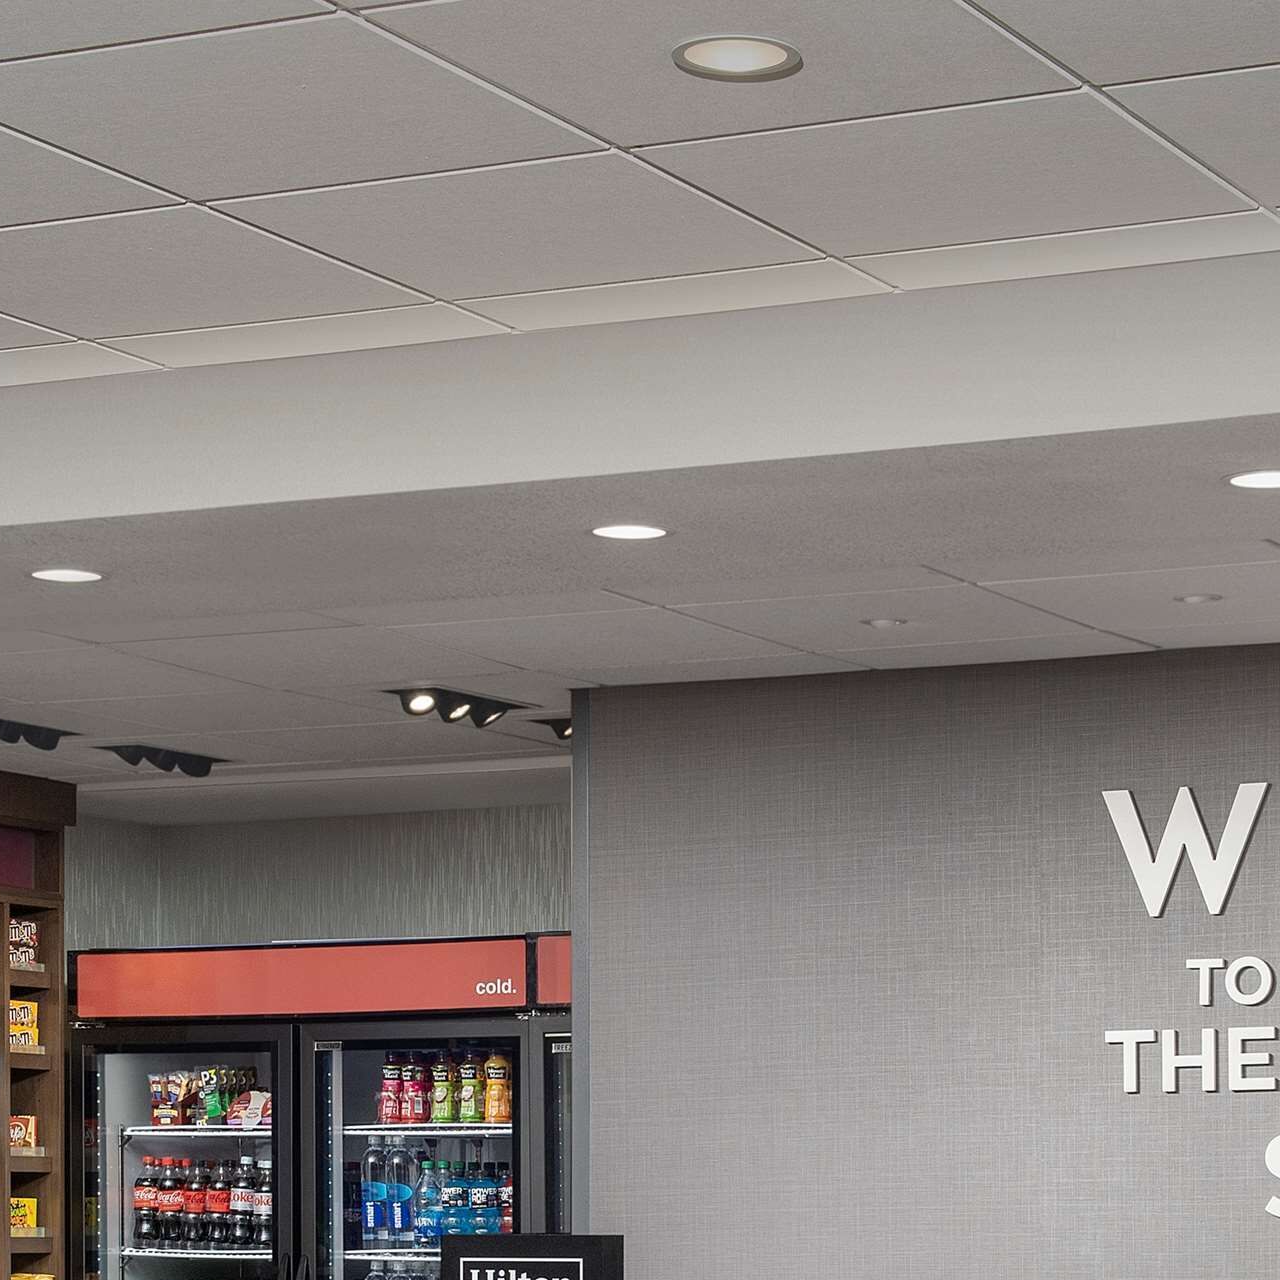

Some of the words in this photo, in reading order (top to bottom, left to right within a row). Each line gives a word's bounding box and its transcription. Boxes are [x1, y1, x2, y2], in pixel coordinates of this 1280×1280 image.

[475, 979, 518, 995] cold.
[1186, 956, 1276, 1007] TO
[1104, 1026, 1278, 1093] THE
[201, 1069, 218, 1086] P3
[367, 1201, 375, 1227] smart
[394, 1202, 402, 1228] smart
